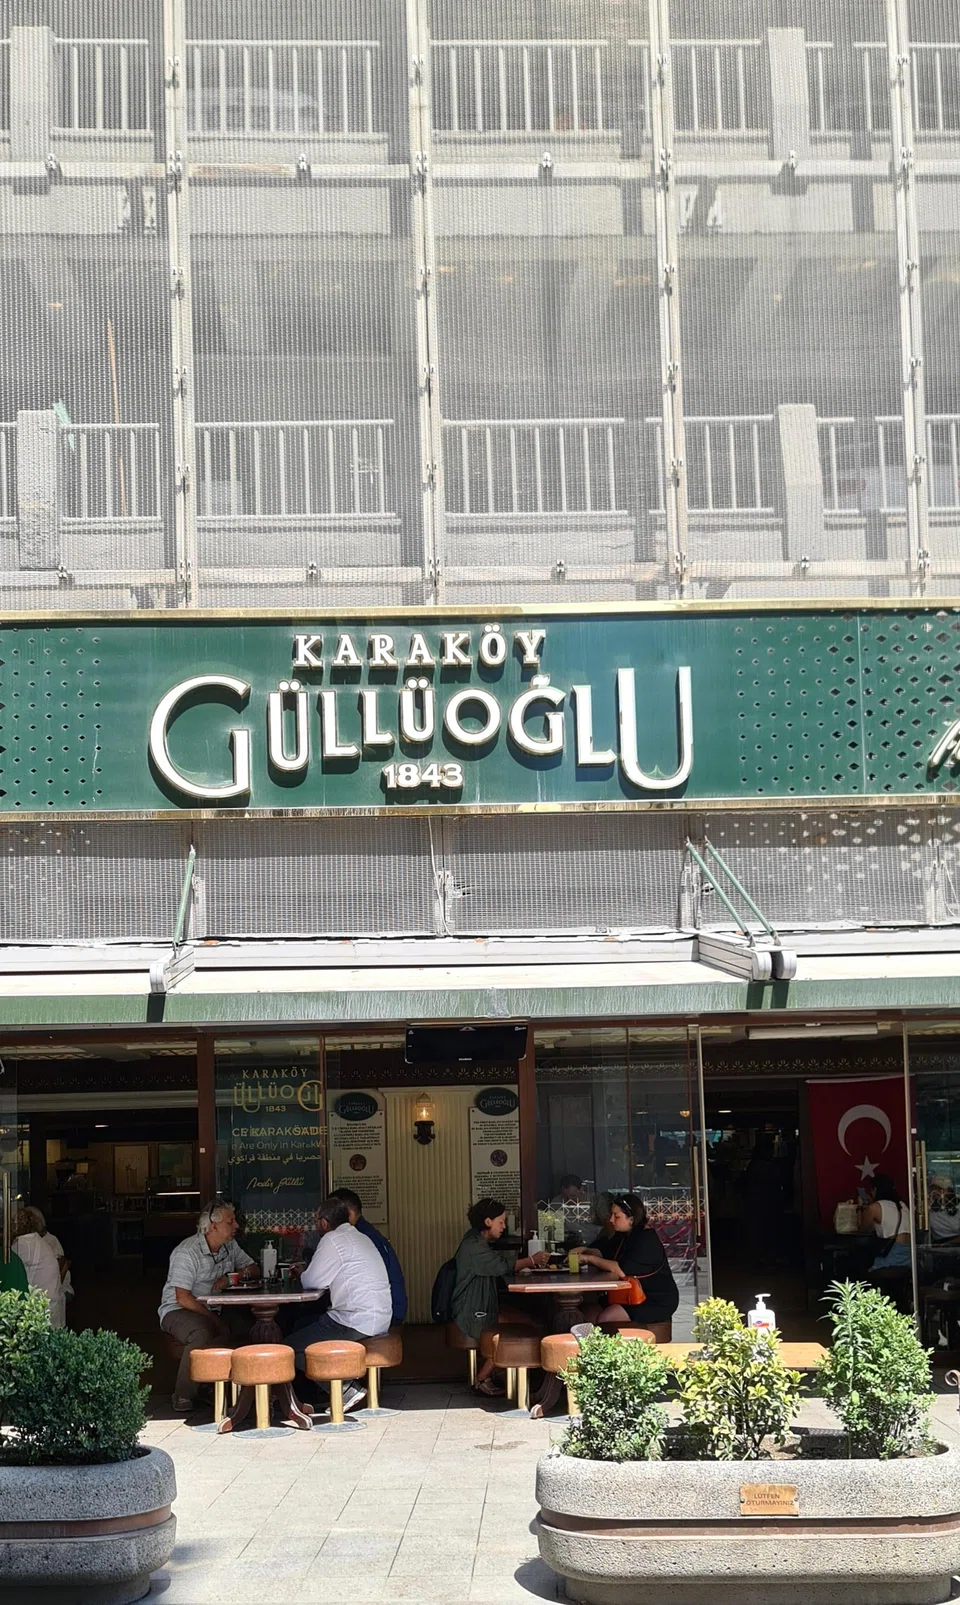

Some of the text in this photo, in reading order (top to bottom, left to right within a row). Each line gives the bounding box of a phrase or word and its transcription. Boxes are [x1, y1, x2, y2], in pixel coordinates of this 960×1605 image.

[293, 623, 546, 668] KARAKÖY
[148, 666, 693, 799] GÜLLÜOĞLU
[382, 763, 463, 789] 1843
[242, 1066, 308, 1079] KARAKÖY
[265, 1105, 286, 1113] 1843
[256, 1142, 278, 1151] Only
